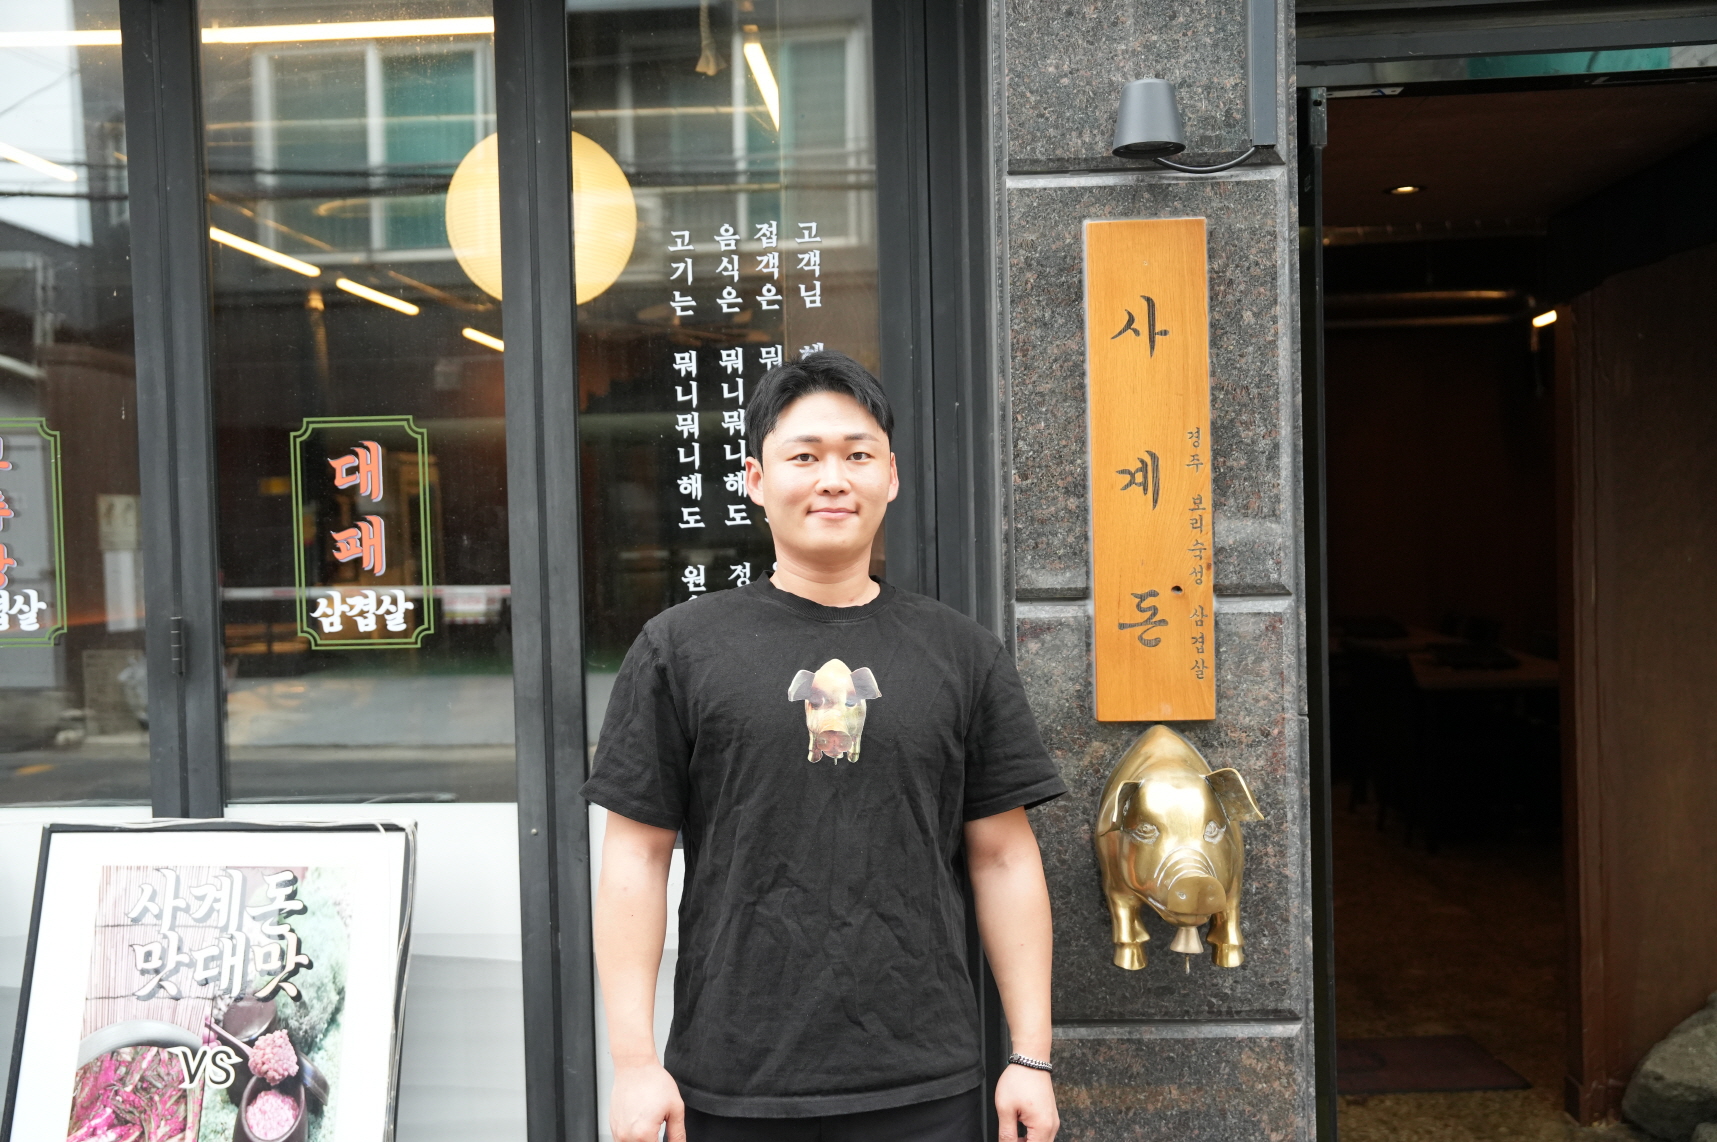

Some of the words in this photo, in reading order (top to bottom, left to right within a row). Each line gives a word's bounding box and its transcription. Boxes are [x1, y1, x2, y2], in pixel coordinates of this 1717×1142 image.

[668, 230, 697, 316] 고기는
[714, 223, 743, 313] 음식은
[754, 221, 783, 310] 접객은
[795, 222, 822, 309] 고객님
[673, 350, 706, 529] 뭐니뭐니해도
[719, 347, 752, 526] 뭐니뭐니해도
[1185, 427, 1203, 473] 경주
[327, 440, 386, 577] 대패
[1187, 494, 1207, 585] 보리숙성
[310, 588, 414, 633] 삼겹살
[681, 564, 707, 600] 원
[1189, 605, 1209, 680] 삼겹살
[125, 867, 308, 940] 사계돈
[129, 930, 313, 1002] 맛대맛
[166, 1046, 243, 1089] VS
